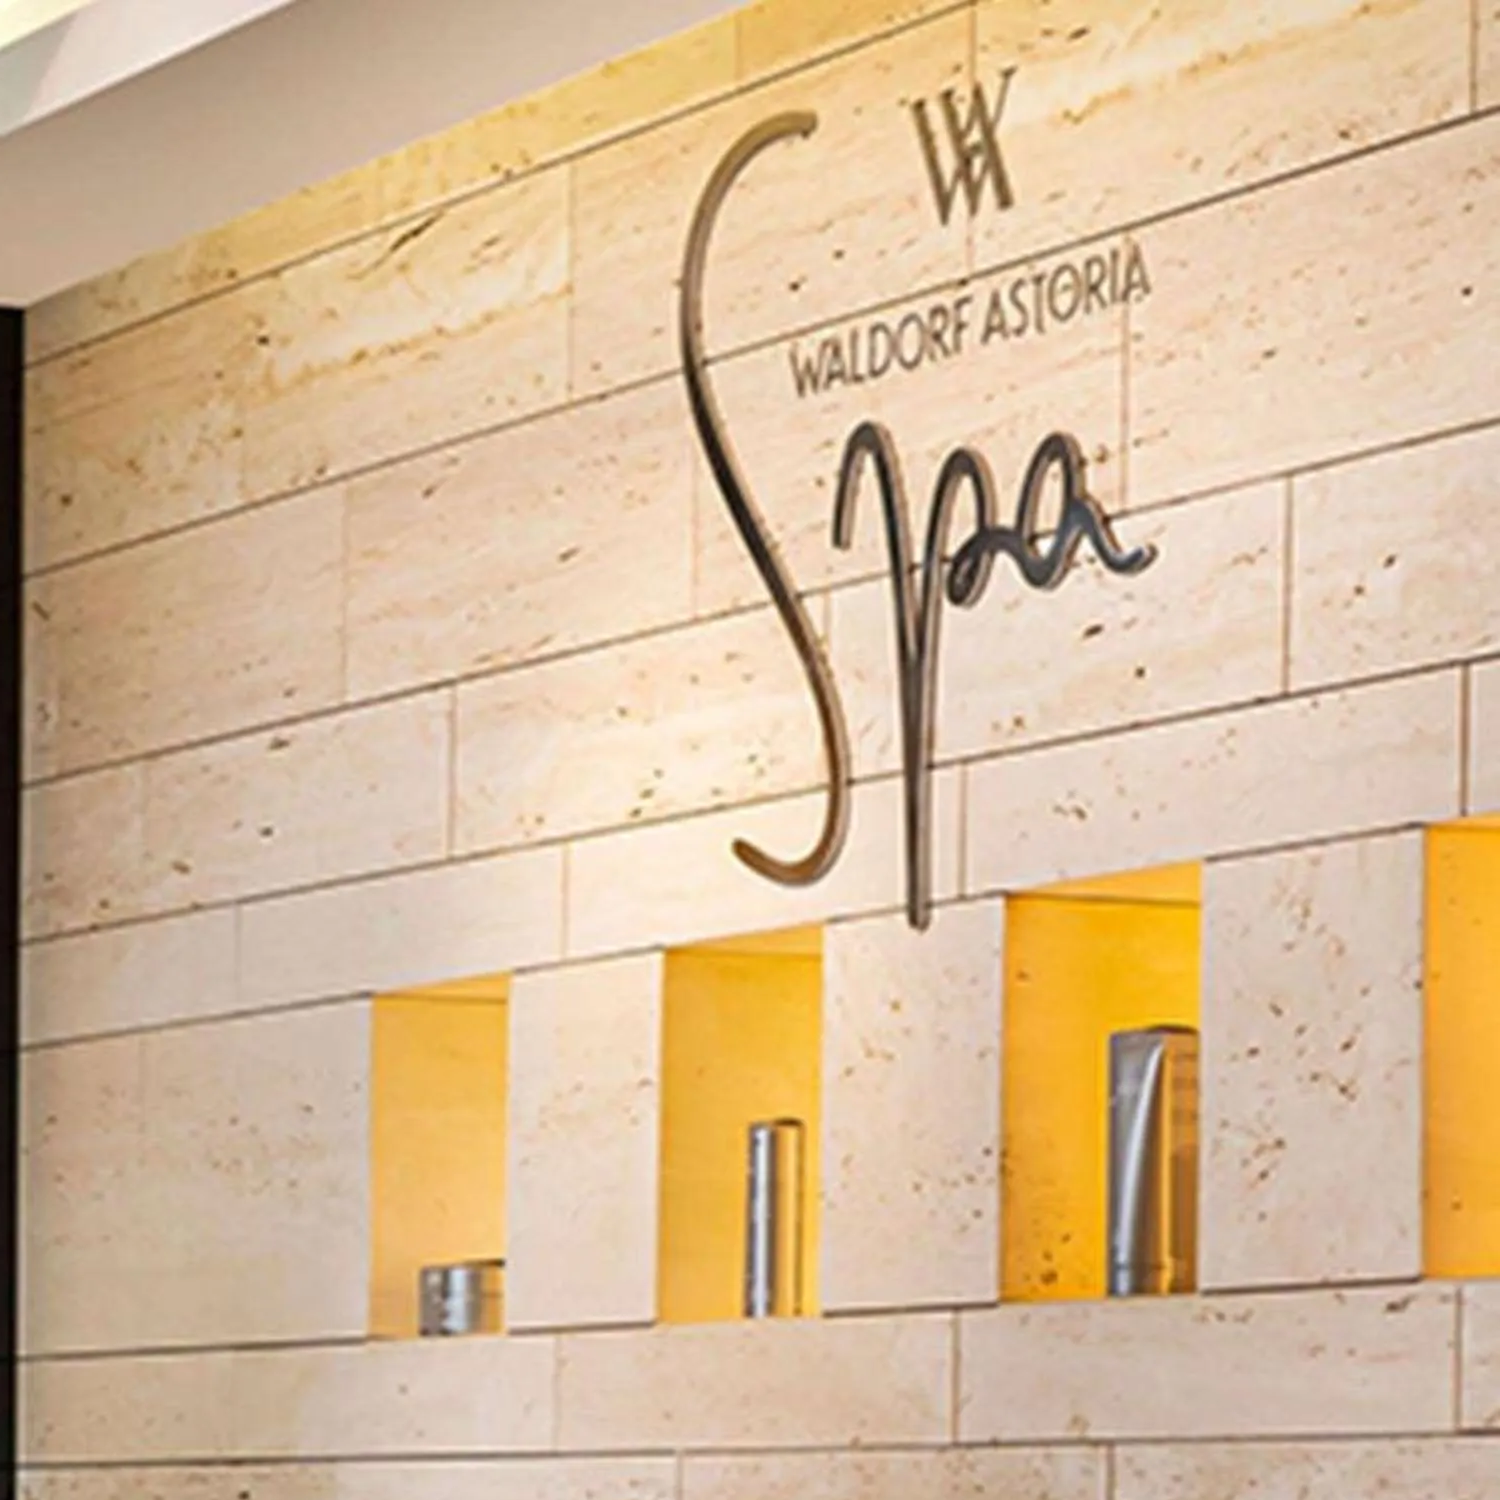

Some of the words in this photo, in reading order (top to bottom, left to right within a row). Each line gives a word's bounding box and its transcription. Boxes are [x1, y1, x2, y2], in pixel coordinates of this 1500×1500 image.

[680, 110, 1158, 931] Spa
[789, 294, 973, 398] WALDORF
[980, 238, 1153, 346] ASTORIA
